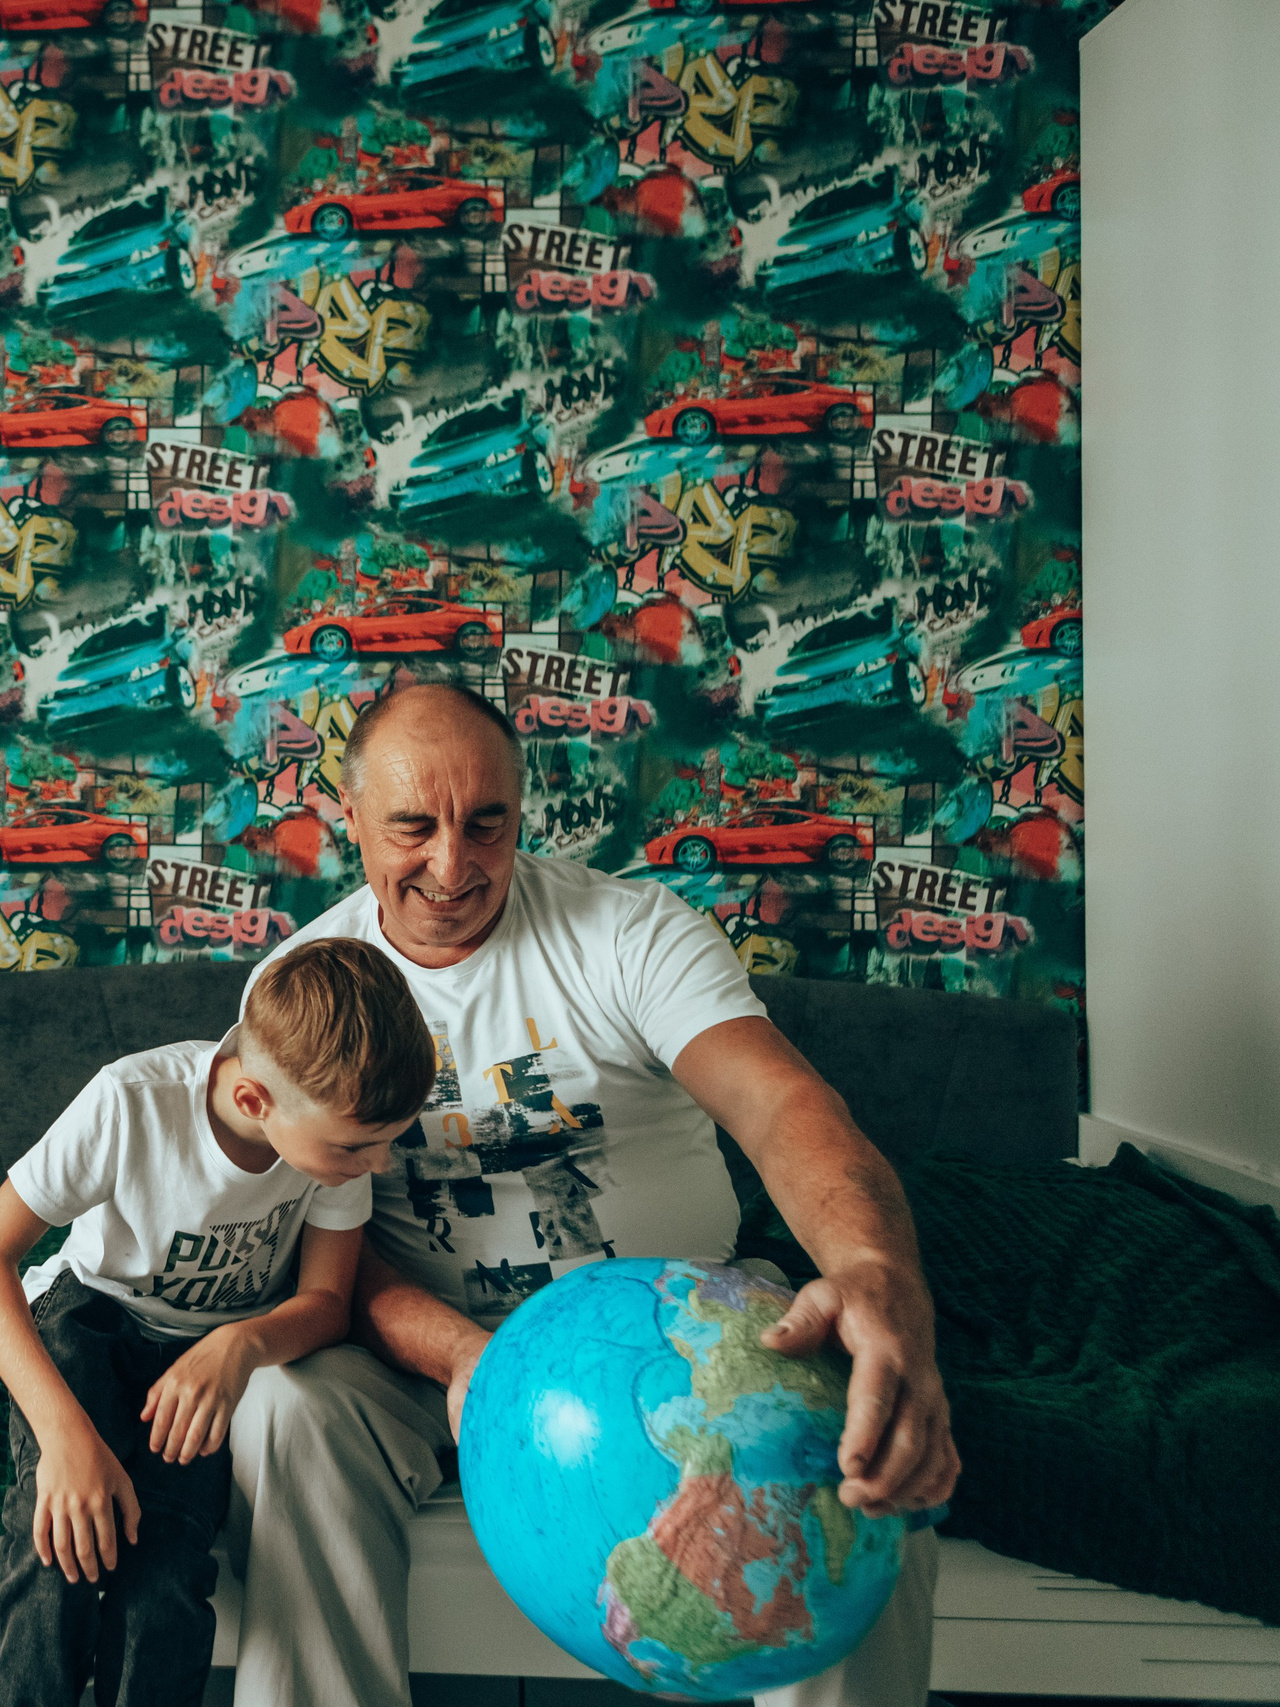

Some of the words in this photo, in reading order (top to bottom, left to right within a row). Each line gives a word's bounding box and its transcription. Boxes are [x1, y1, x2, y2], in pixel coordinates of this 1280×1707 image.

[875, 0, 1006, 43] STREET
[148, 23, 269, 68] STREET
[505, 224, 628, 270] STREET
[147, 443, 268, 488] STREET
[873, 430, 1004, 477] STREET
[504, 649, 627, 695] STREET
[148, 861, 269, 906] STREET
[873, 863, 1004, 911] STREET
